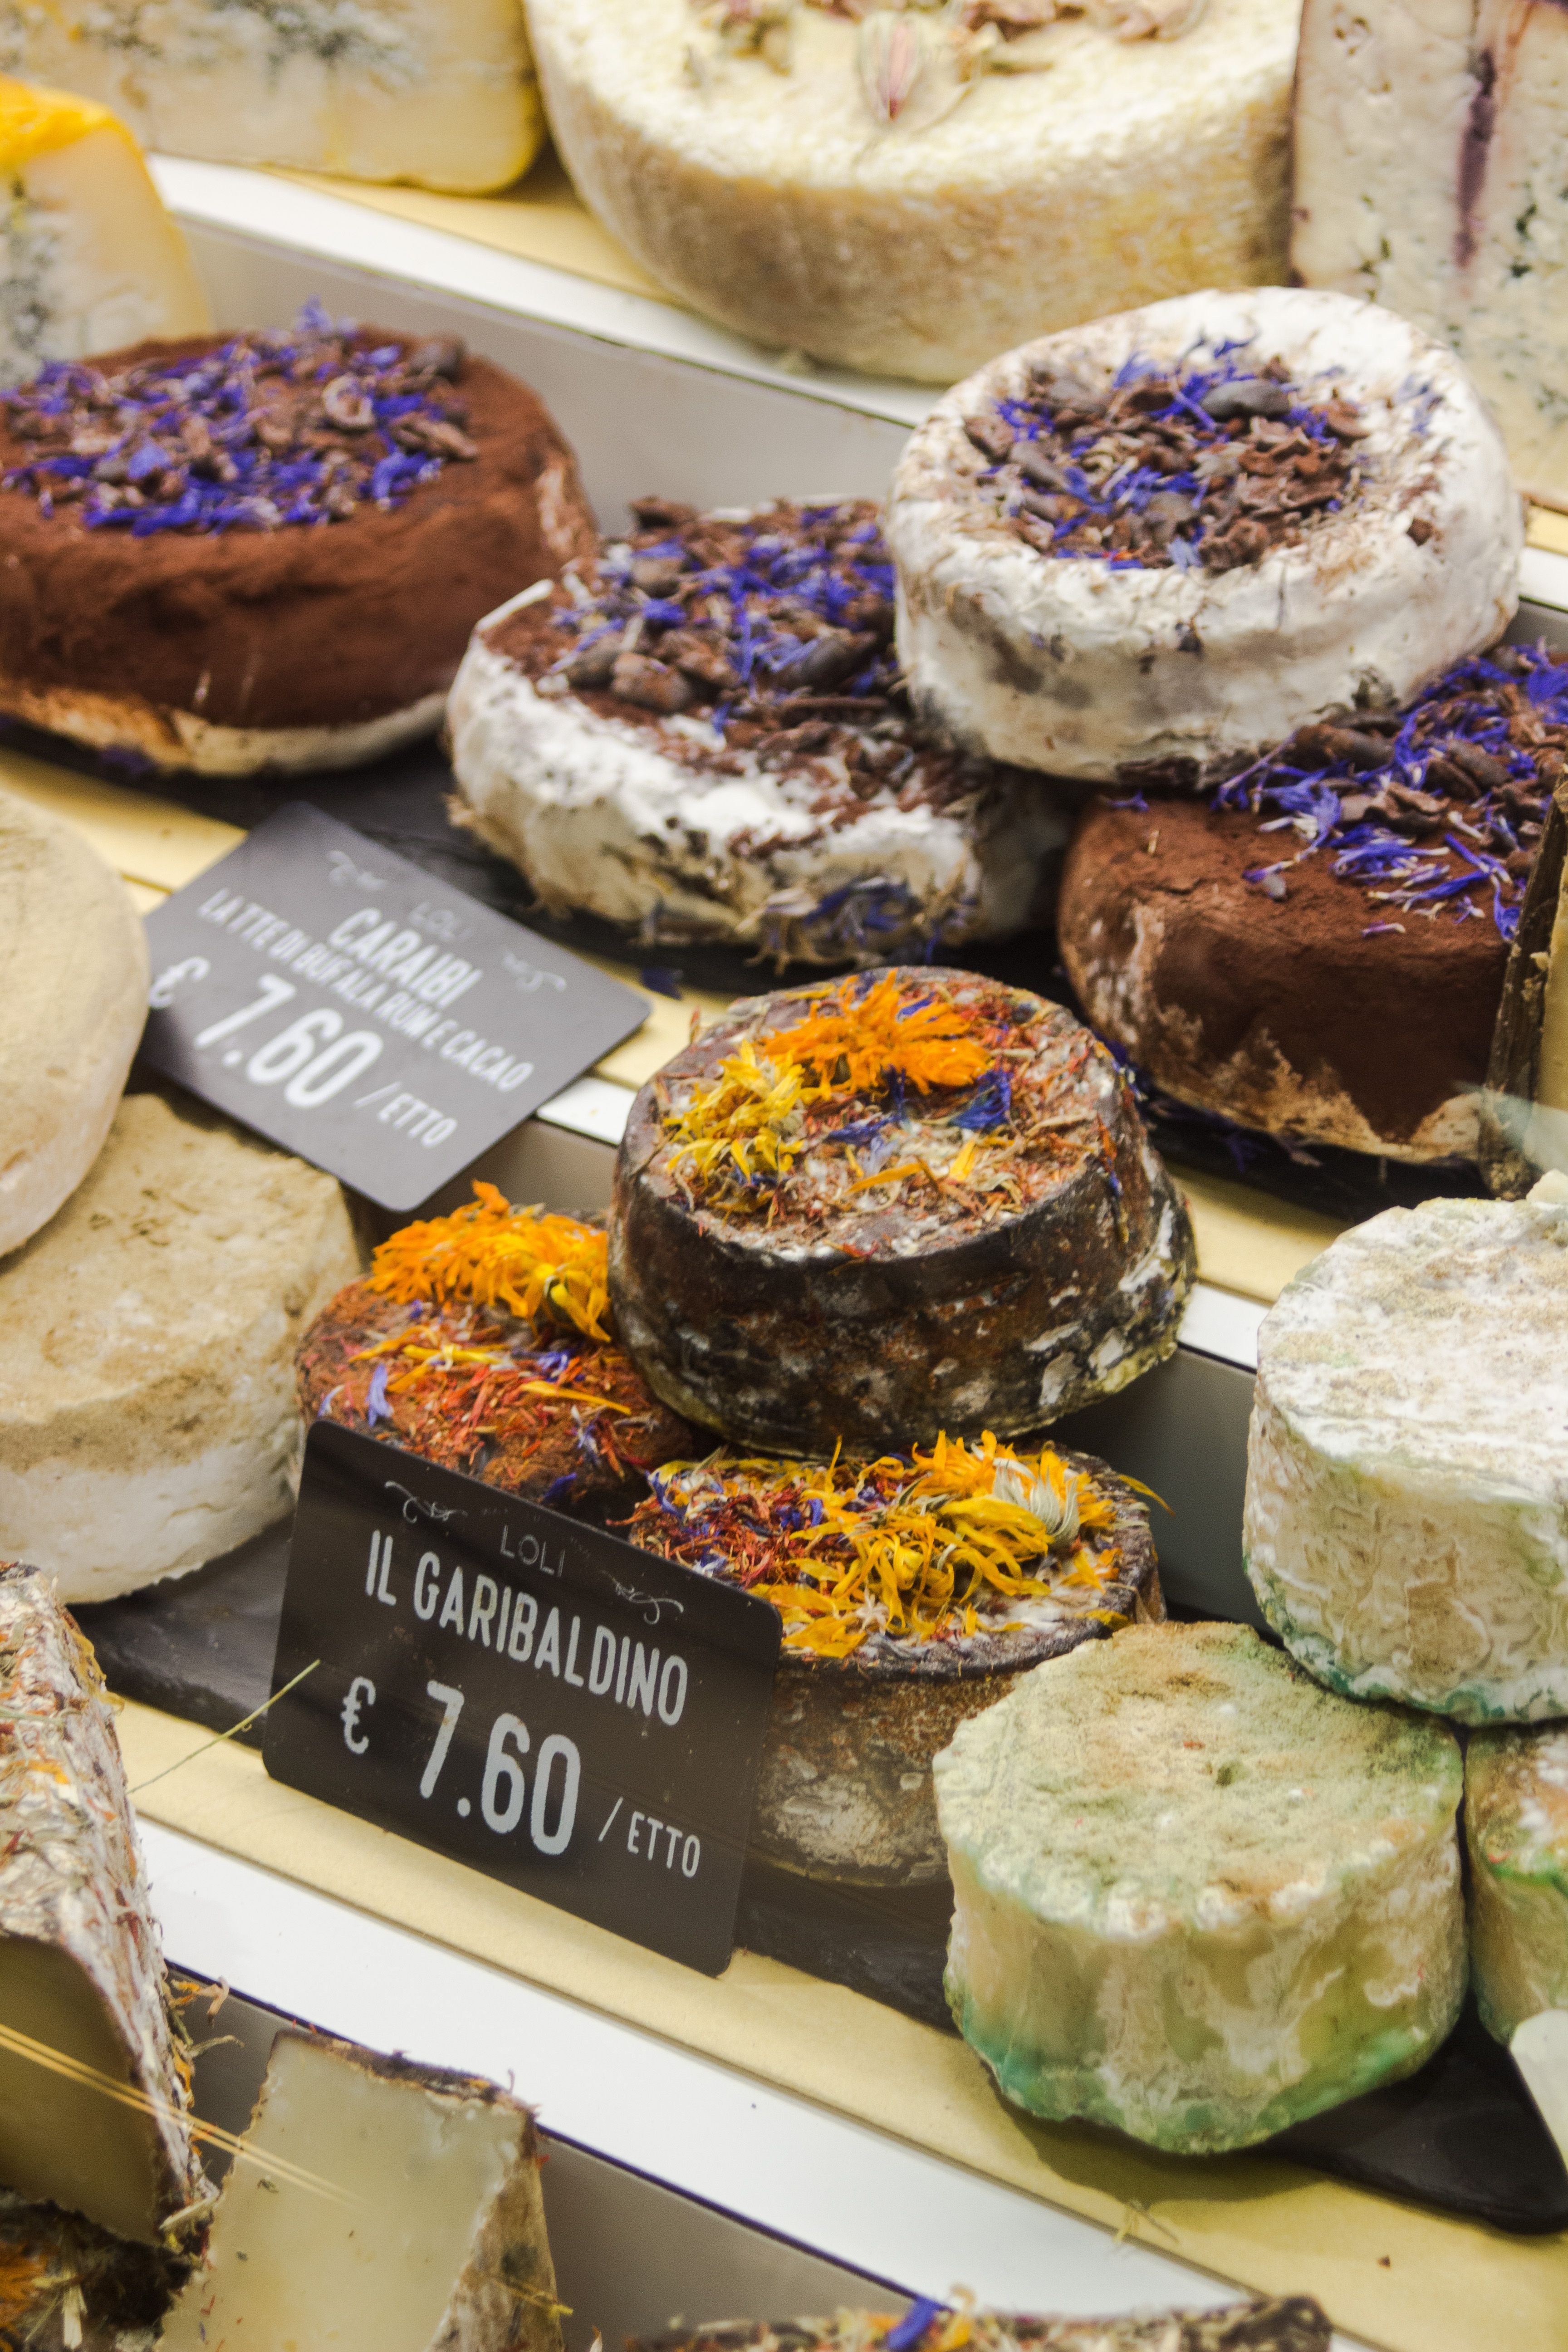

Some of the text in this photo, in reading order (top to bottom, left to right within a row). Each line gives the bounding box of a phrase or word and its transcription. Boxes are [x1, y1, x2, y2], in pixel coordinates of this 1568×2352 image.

[148, 956, 211, 1008] €
[195, 973, 384, 1109] 7.60
[198, 889, 534, 1092] LATTE DI BUFALA RUM E CACAO
[329, 909, 480, 1008] CARAIBI
[365, 1529, 398, 1607] IL
[412, 1551, 689, 1727] GARIBALDINO
[500, 1524, 566, 1576] LOLI
[340, 1676, 377, 1755] €
[419, 1679, 582, 1856] 7.60
